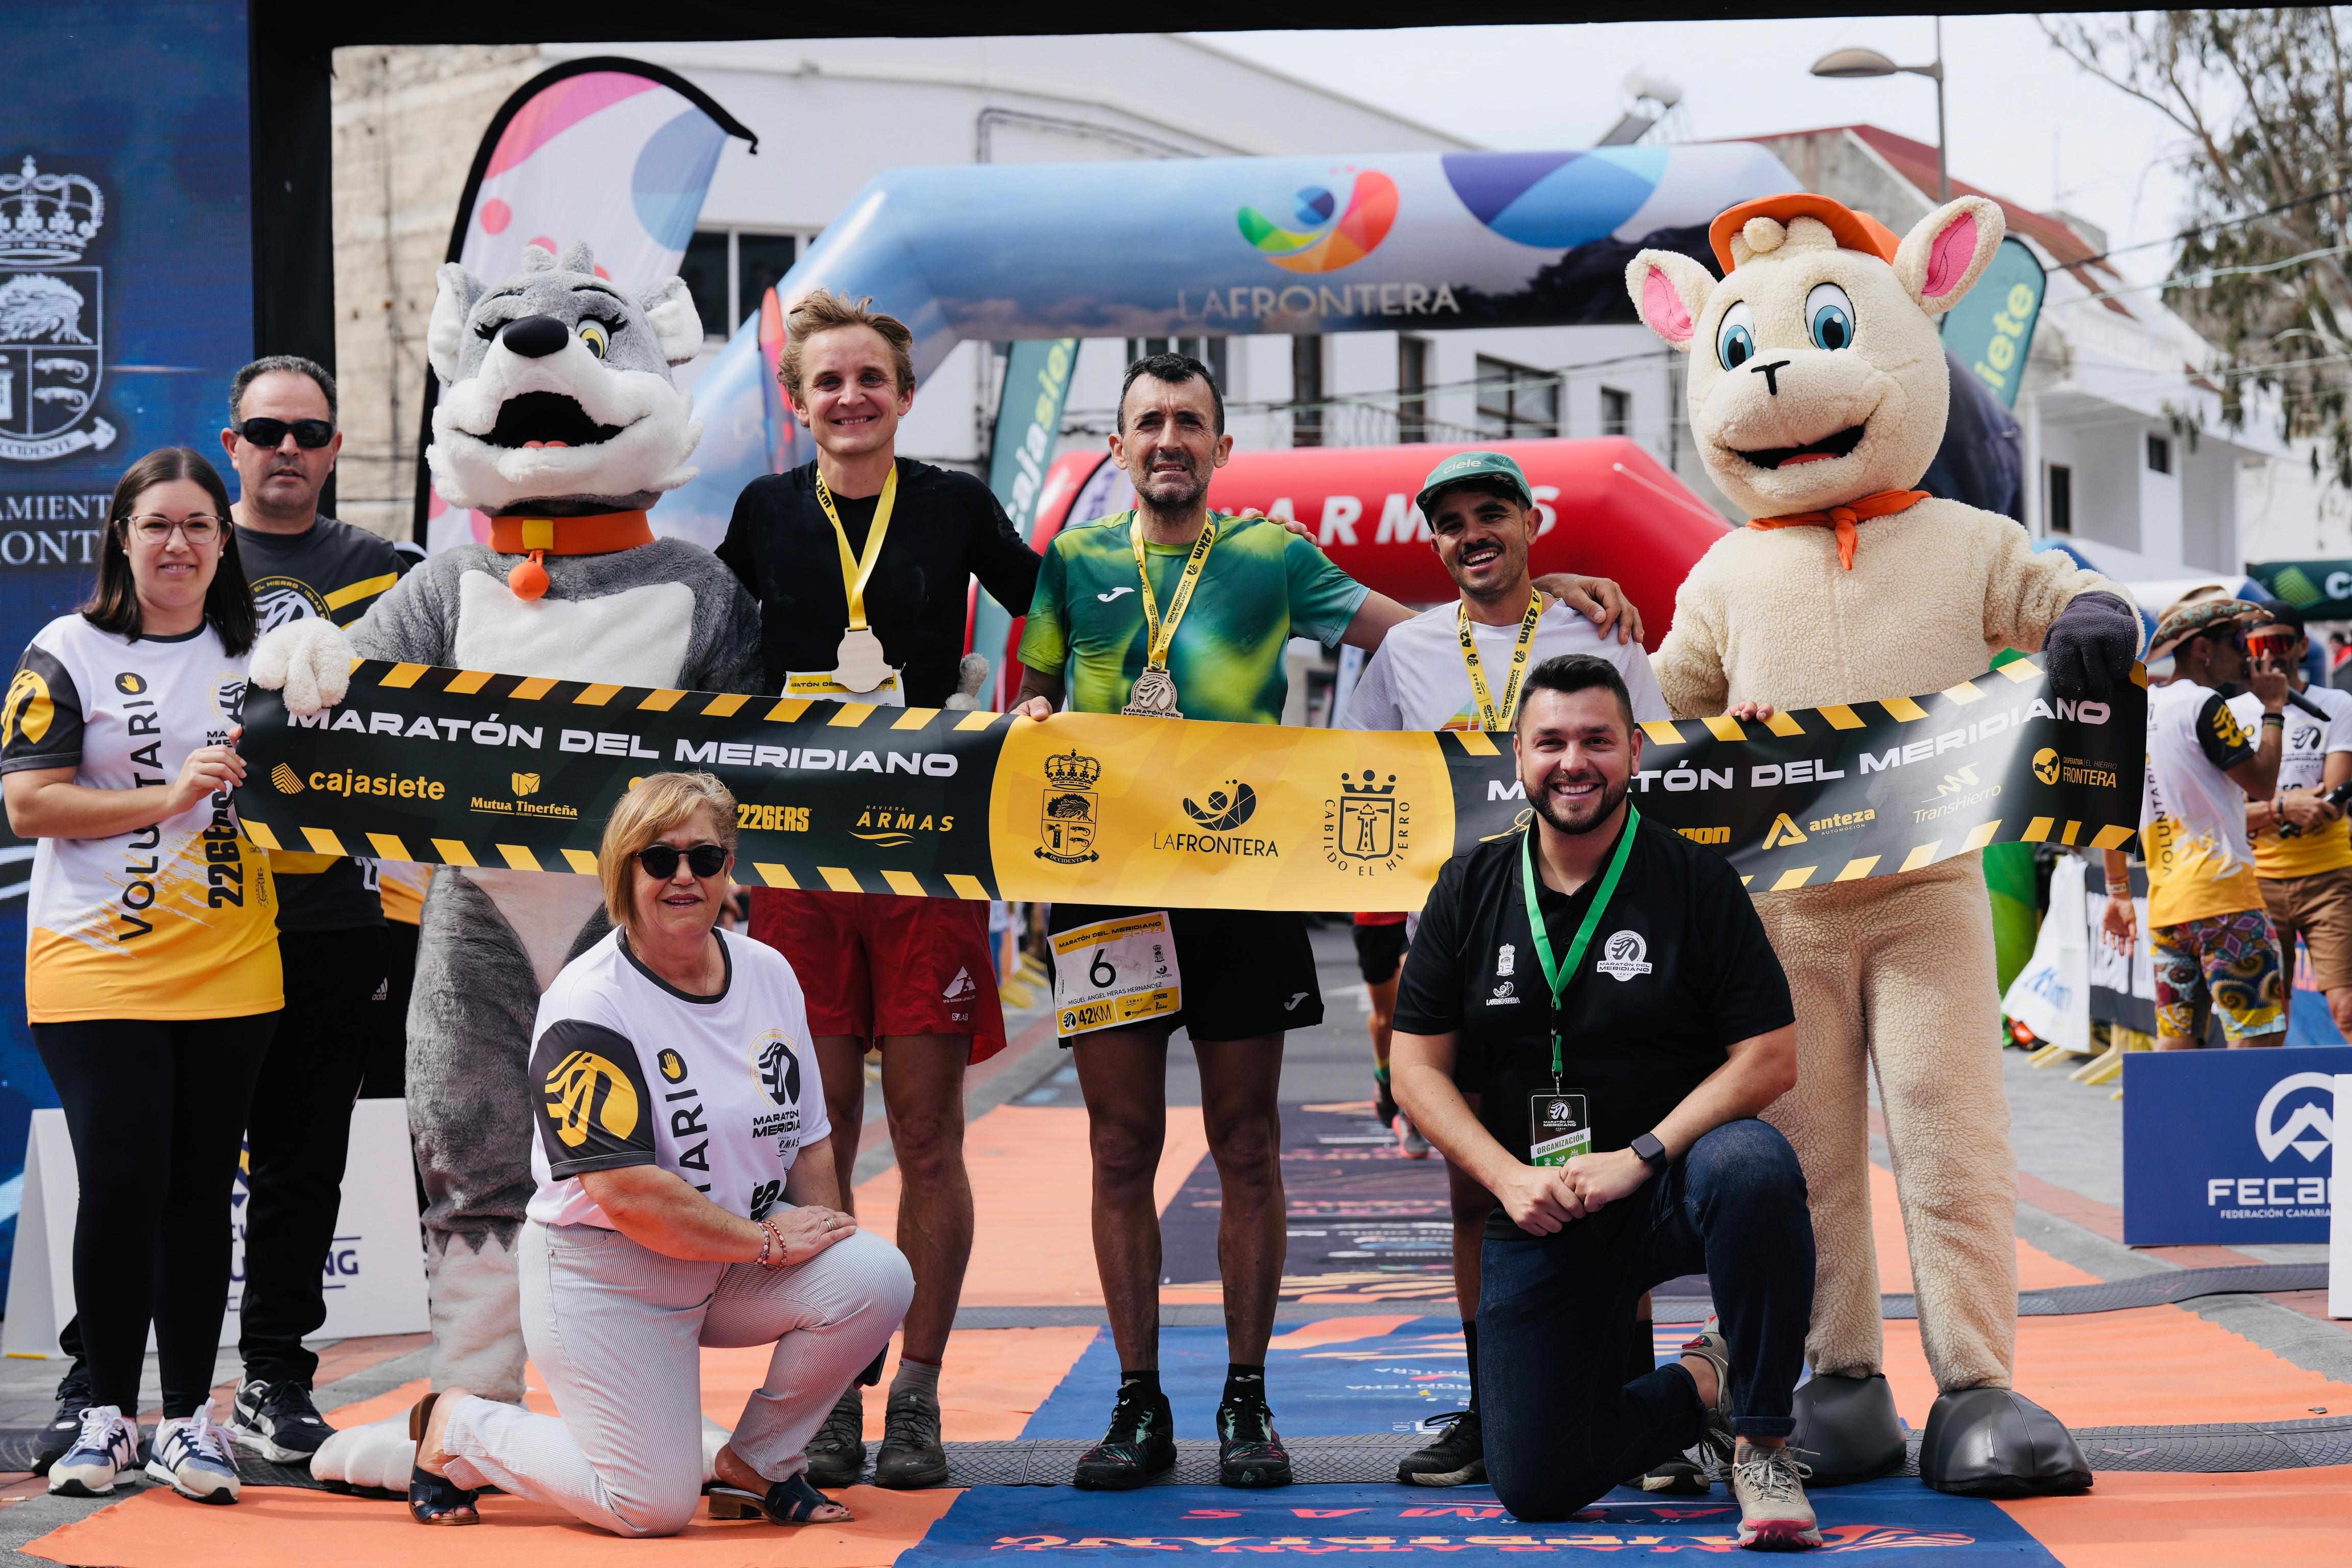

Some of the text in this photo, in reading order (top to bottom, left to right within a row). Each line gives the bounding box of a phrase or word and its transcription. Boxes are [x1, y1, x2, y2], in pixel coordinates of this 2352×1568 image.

[1177, 281, 1461, 320] LAFRONTERA
[1443, 458, 1482, 474] ciele
[1193, 526, 1218, 560] 42km
[266, 580, 299, 590] HIERRO
[1518, 607, 1538, 645] 42km
[1501, 669, 1517, 719] MERIDIANO
[287, 708, 959, 777] MARATÓN DEL MERIDIANO
[1751, 760, 1845, 788] DEL
[1859, 698, 2112, 775] MERIDIANO
[2093, 760, 2118, 770] HIERRO
[309, 769, 445, 801] cajasiete
[2063, 766, 2117, 789] FRONTERA
[471, 797, 578, 816] Mutua Tinerfeña
[1913, 783, 2002, 824] TransHierro
[737, 804, 810, 832] 226ERS
[855, 812, 954, 832] ARMAS
[1809, 808, 1876, 832] anteza
[1821, 824, 1866, 836] AUTOMOCIÓN
[1154, 832, 1279, 857] LAFRONTERA
[1323, 799, 1410, 876] CABILDO EL HIERRO
[1049, 854, 1084, 864] OCCIDENTE
[1059, 934, 1091, 948] MARATÓN
[1111, 921, 1162, 934] MERIDIANO
[1089, 948, 1116, 989] 6
[1068, 982, 1163, 1006] MIGUEL ANGEL HERAS HERNANDEZ
[1079, 1003, 1112, 1026] 42KM
[1537, 1133, 1584, 1155] ORGANIZACIÓN
[2220, 1207, 2284, 1219] FEDERACIÓN
